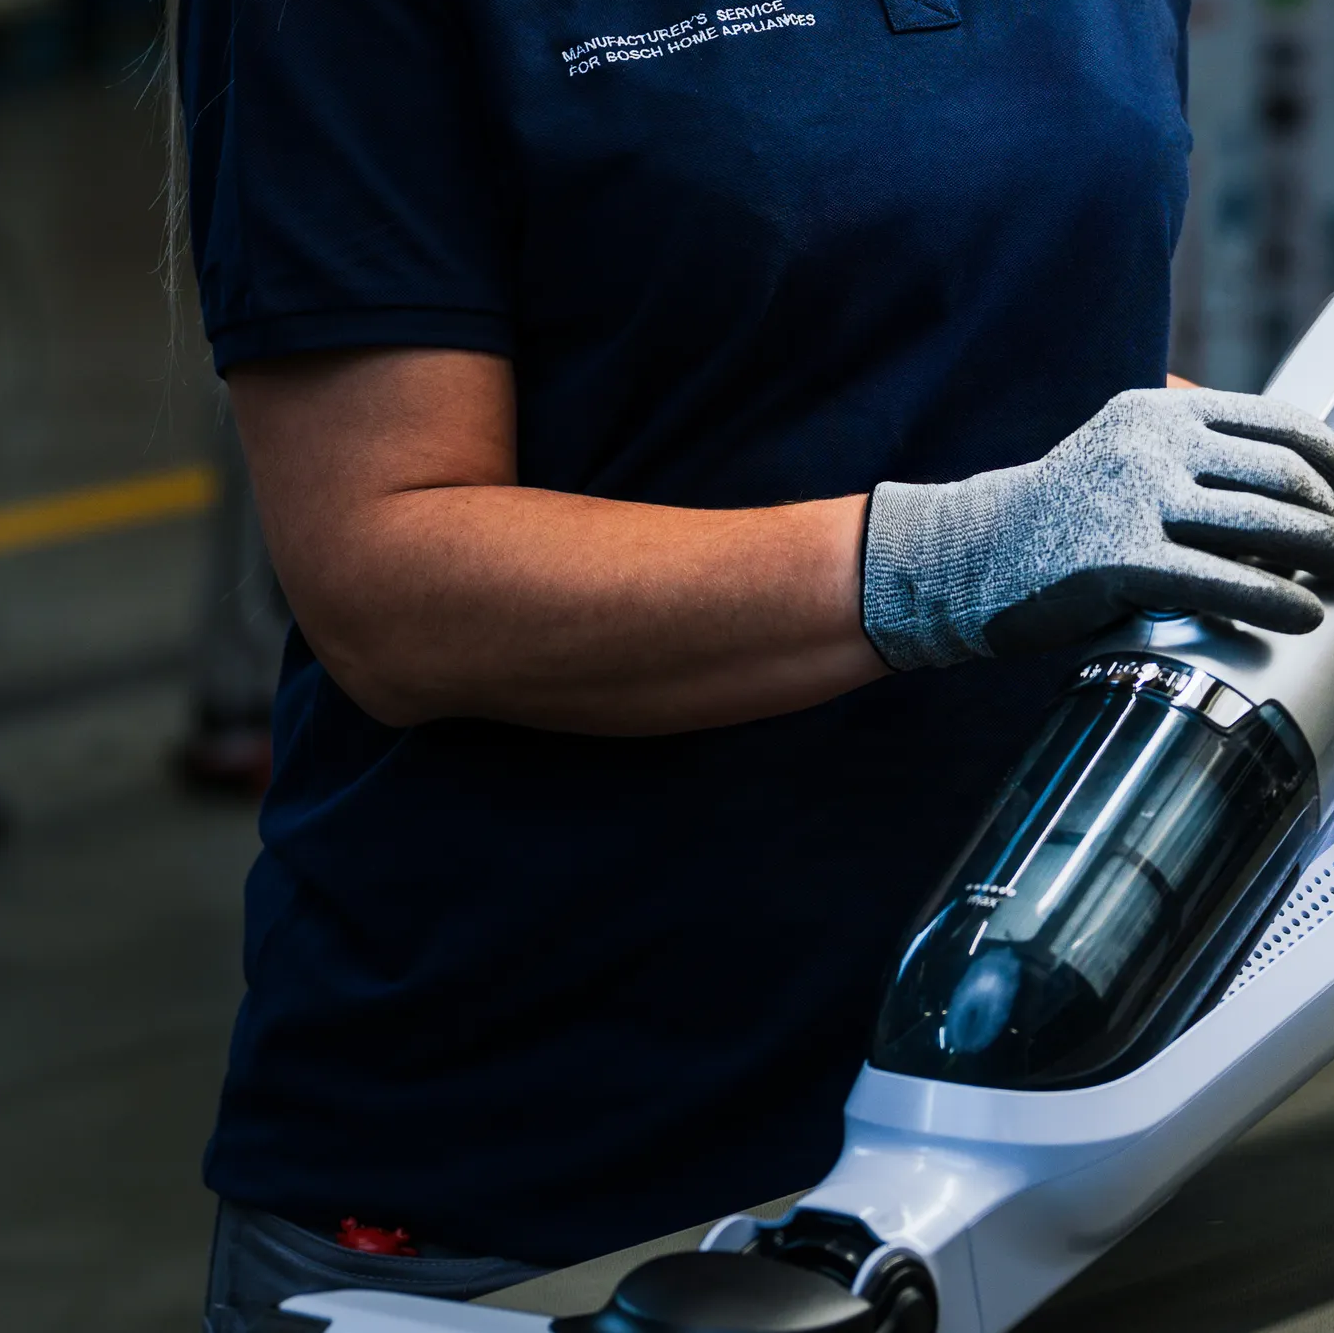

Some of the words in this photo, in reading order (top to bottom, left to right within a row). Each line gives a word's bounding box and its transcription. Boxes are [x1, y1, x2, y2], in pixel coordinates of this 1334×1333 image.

[561, 13, 708, 63] MANUFACTURER'S
[716, 0, 785, 22] SERVICE
[569, 55, 601, 77] FOR
[605, 45, 663, 63] BOSCH
[667, 26, 719, 54] HOME
[722, 13, 816, 37] APPLIANCES
